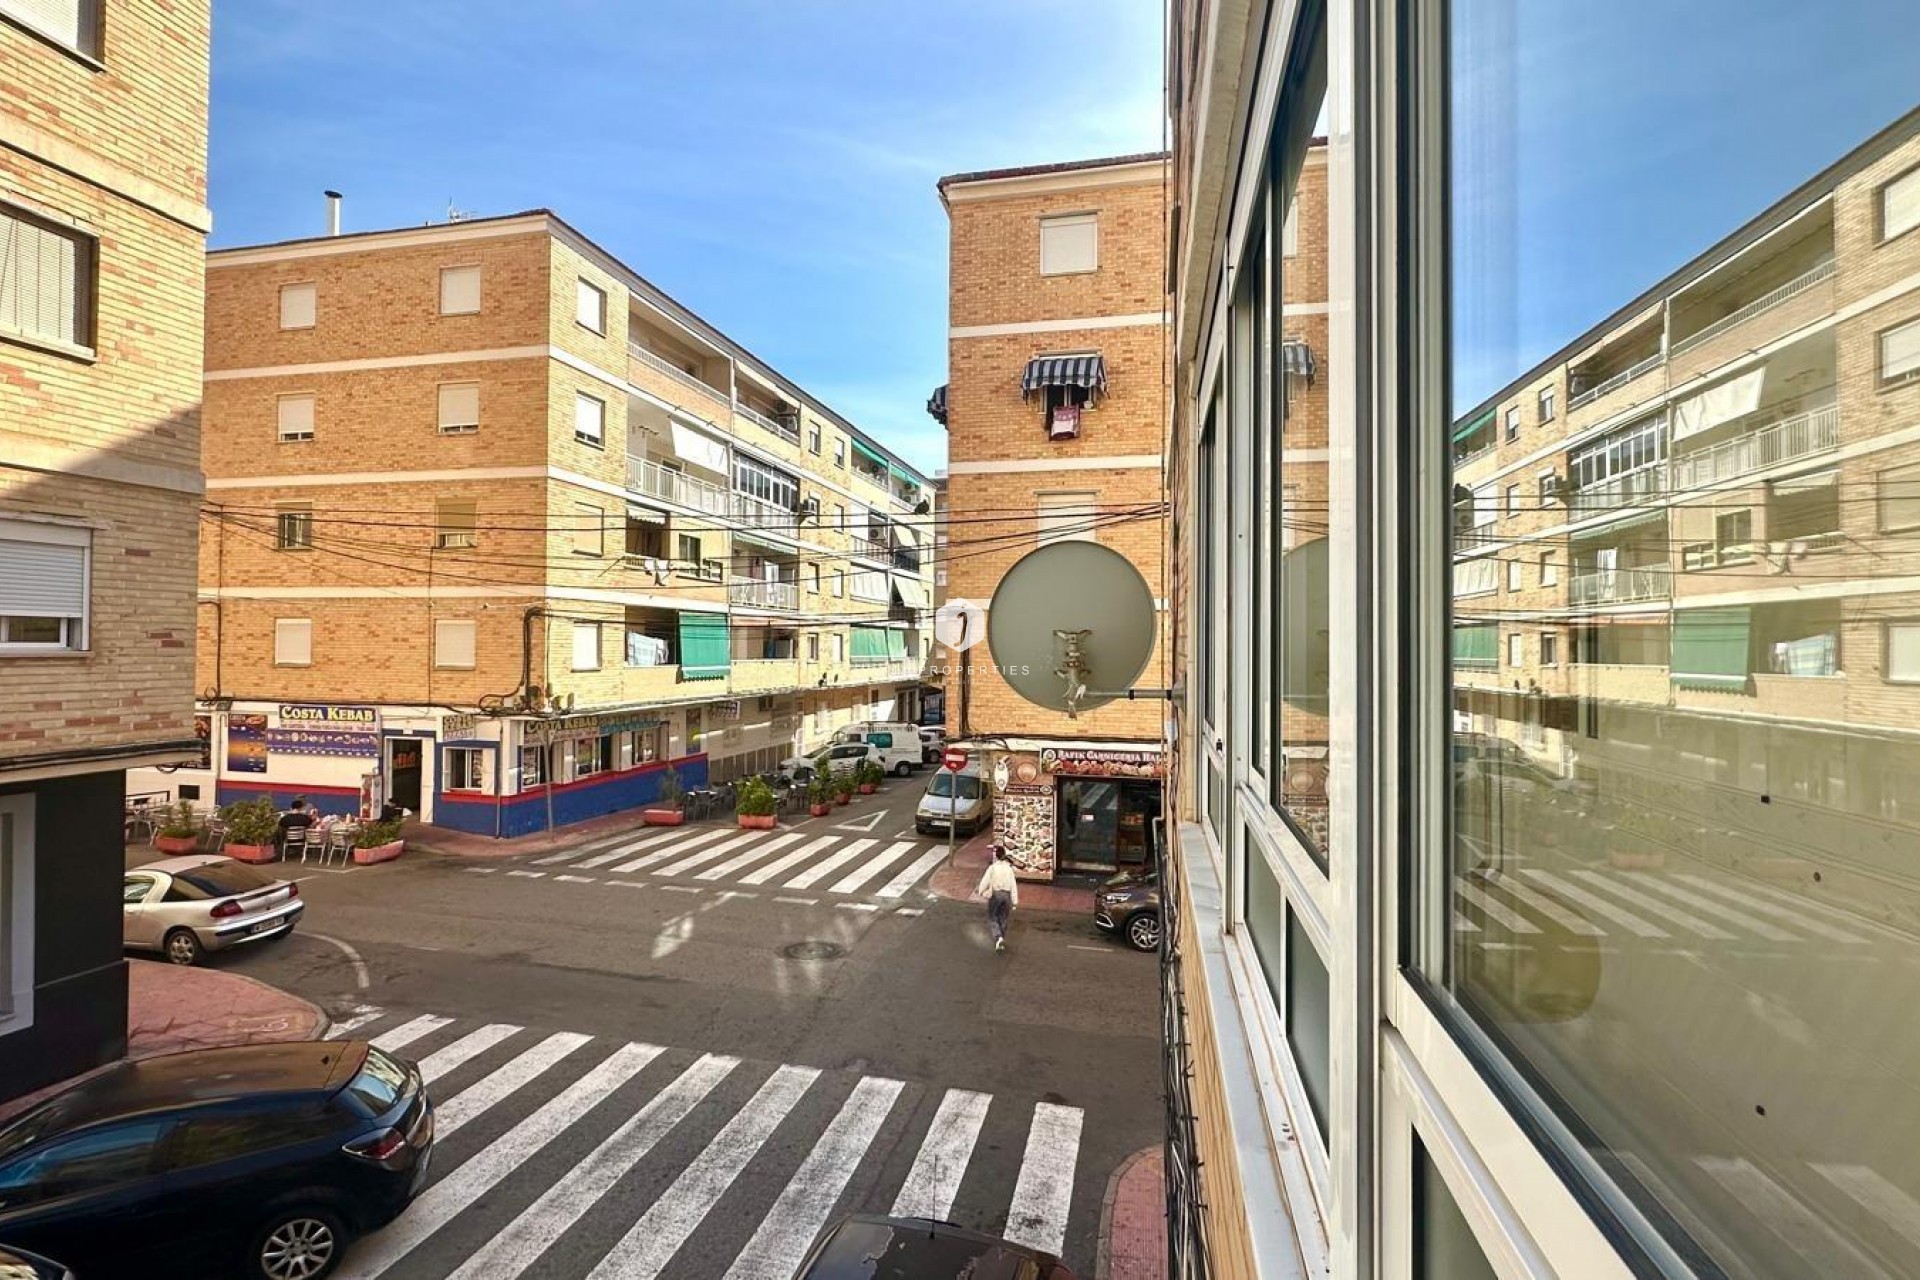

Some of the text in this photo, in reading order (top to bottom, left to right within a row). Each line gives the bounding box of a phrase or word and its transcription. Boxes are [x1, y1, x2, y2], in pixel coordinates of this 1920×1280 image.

[281, 706, 374, 721] COSTA KEBAB
[526, 718, 561, 733] COSTA
[564, 716, 598, 729] KEBAB
